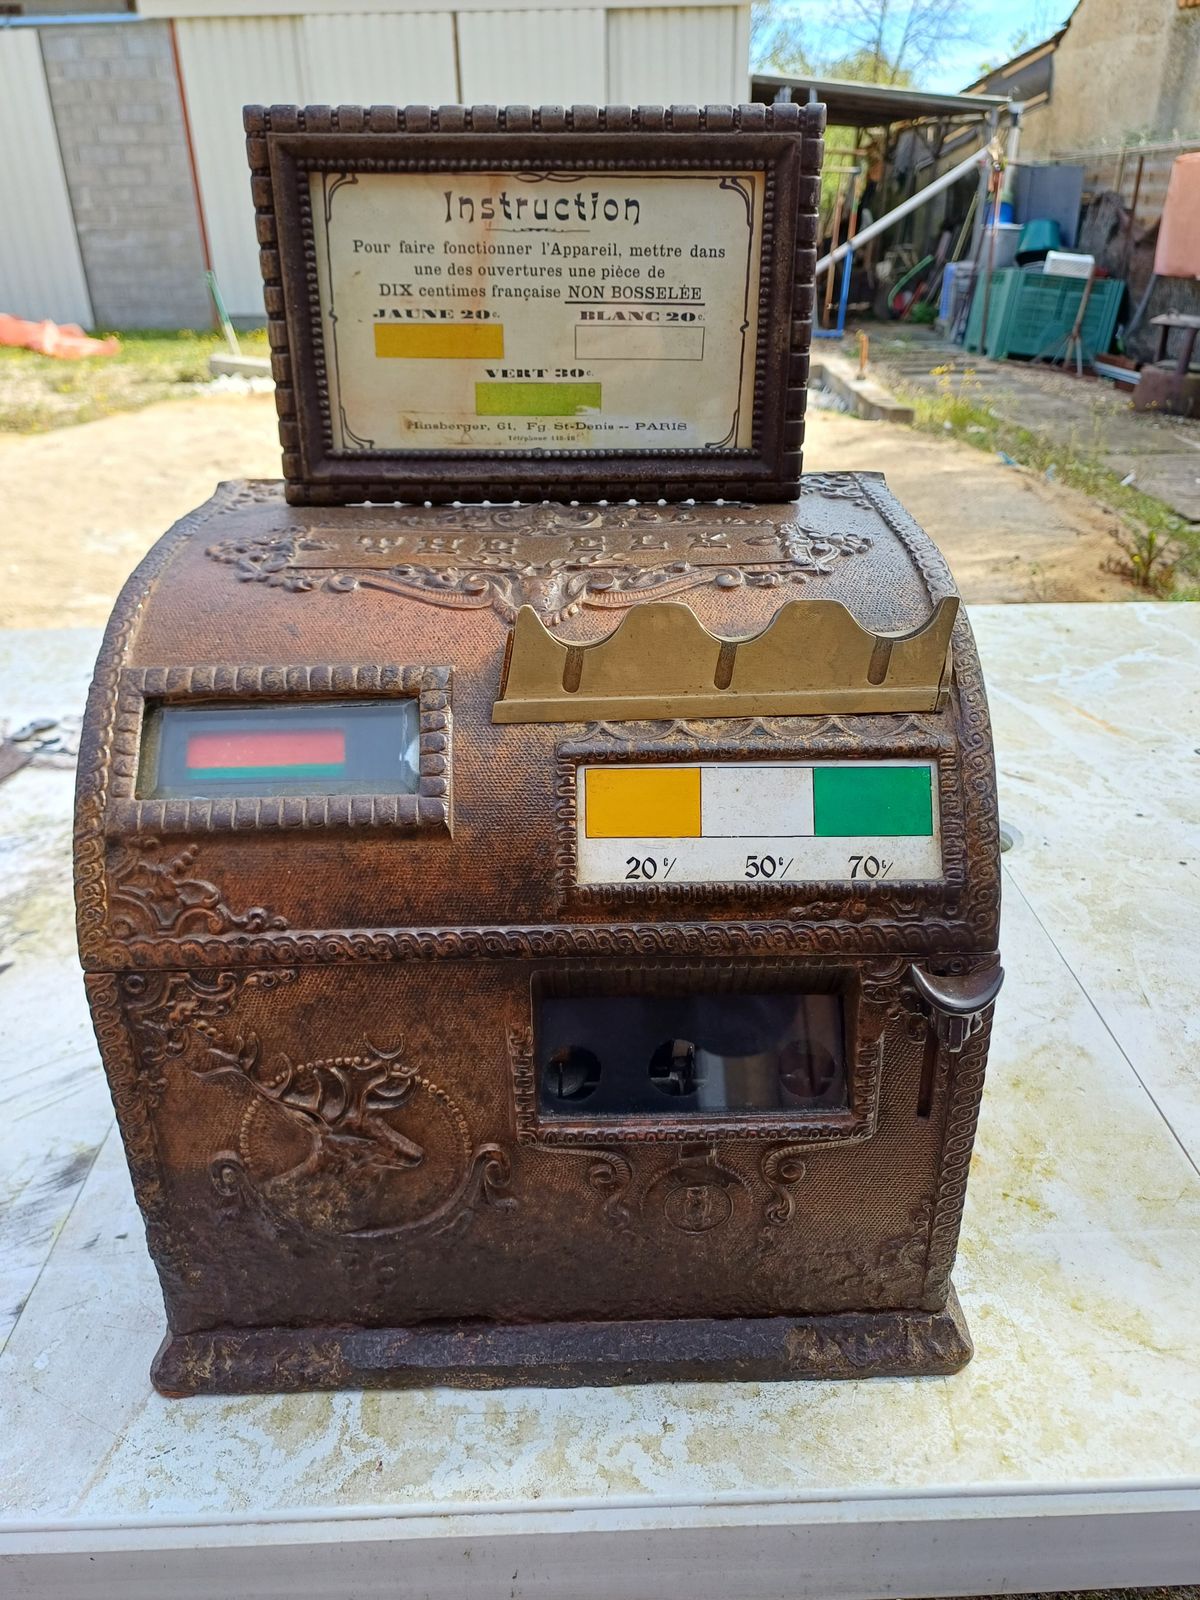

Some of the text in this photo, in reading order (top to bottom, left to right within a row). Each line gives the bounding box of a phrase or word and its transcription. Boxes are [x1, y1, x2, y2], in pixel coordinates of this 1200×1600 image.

[444, 191, 640, 225] Instruction
[353, 240, 726, 258] Pour faire fonctionner l'Appareil, mettre dans
[414, 263, 665, 280] une des ouvertures une pièce de
[379, 283, 702, 301] DIX centimes française NON BOSSELÉE
[373, 309, 454, 319] JAUNE
[580, 311, 660, 321] BLANC
[485, 368, 549, 378] VERT
[635, 422, 688, 431] PARIS
